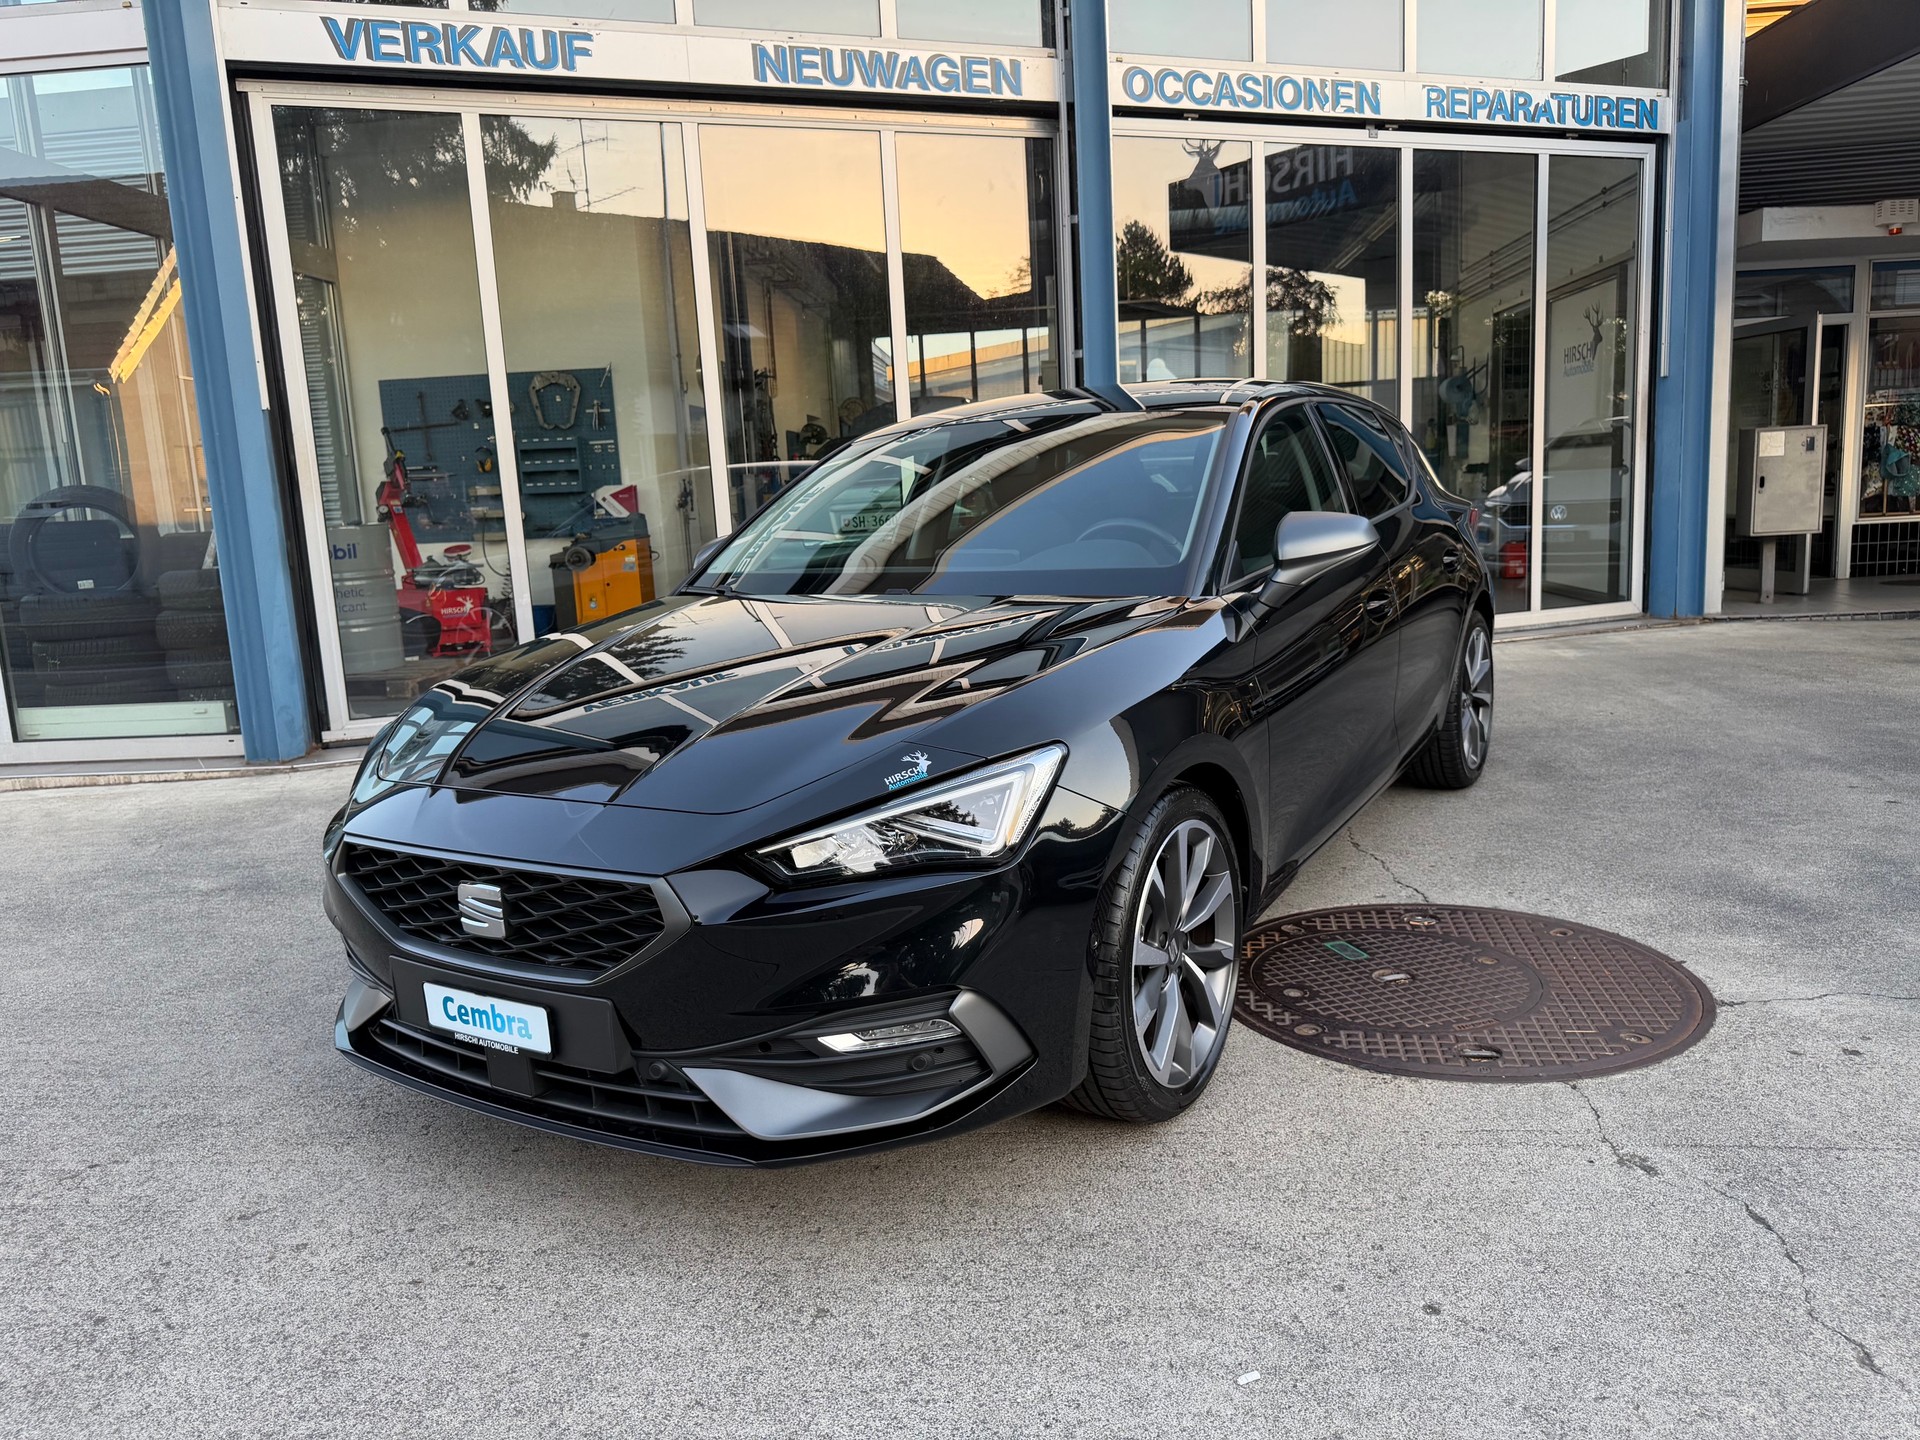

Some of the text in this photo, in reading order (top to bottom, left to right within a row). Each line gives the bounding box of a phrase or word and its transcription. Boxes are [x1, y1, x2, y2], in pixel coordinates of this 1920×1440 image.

[319, 16, 594, 72] VERKAUF
[751, 43, 1022, 96] NEUWAGEN
[1122, 66, 1381, 115] OCCASIONEN
[1422, 84, 1658, 129] REPARATUREN
[442, 996, 532, 1040] Cembra
[454, 1032, 519, 1055] HIRSCHI AUTOMOBILE
